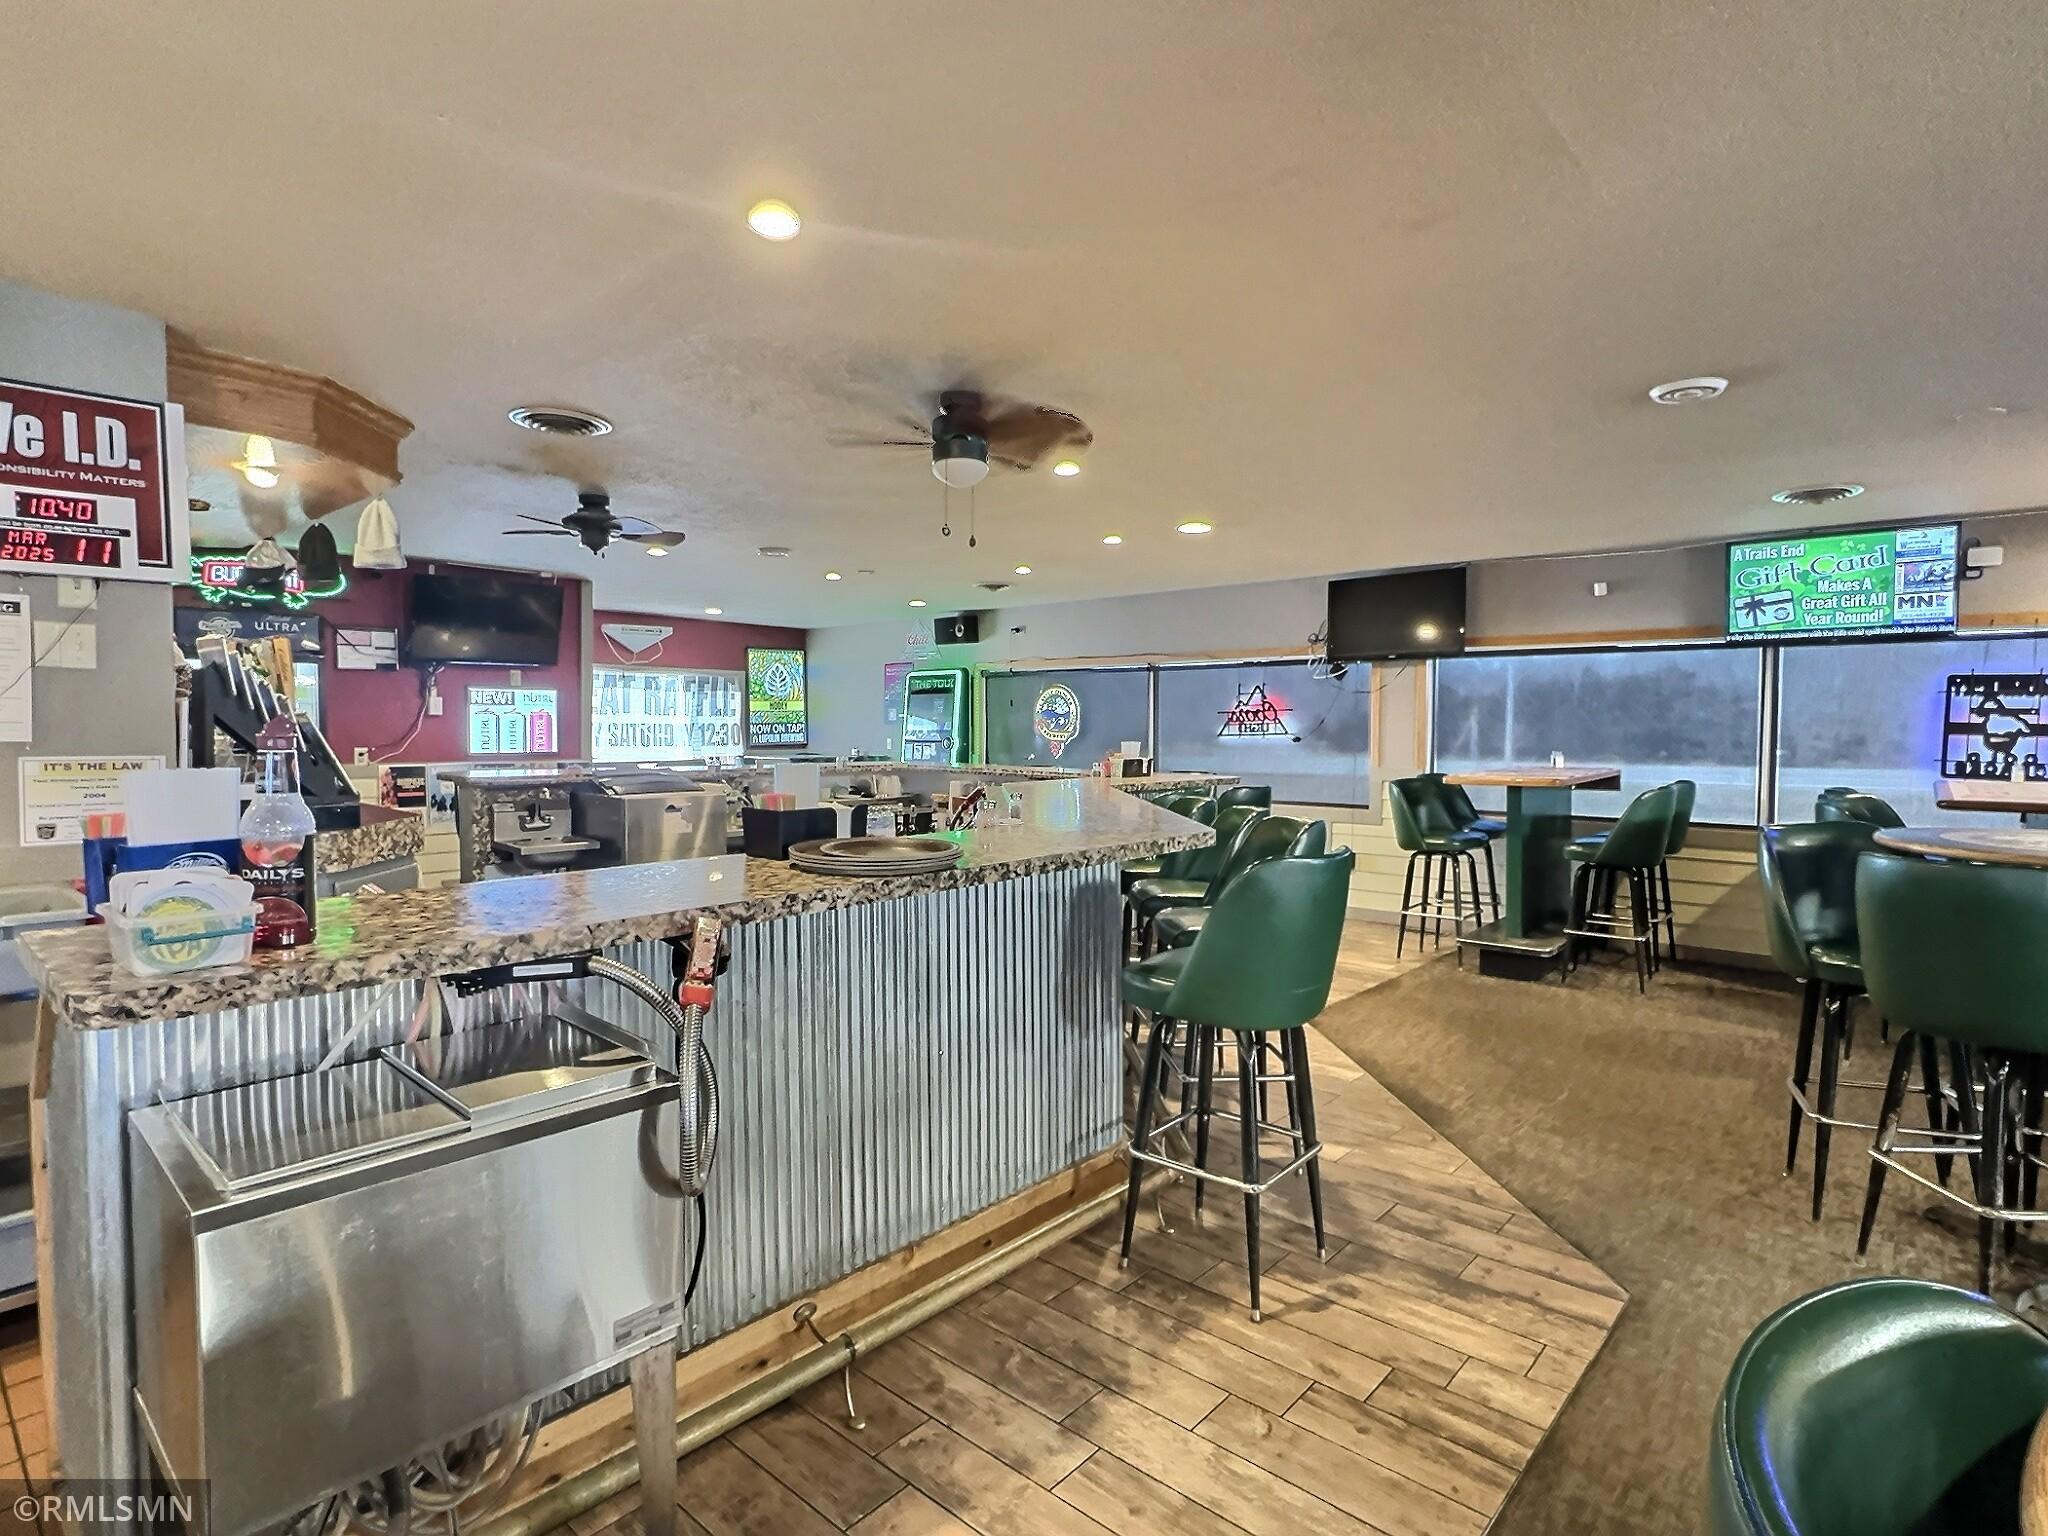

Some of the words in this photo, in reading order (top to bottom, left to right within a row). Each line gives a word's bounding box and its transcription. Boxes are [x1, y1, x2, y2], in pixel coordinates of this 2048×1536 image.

[62, 410, 142, 471] I.D.
[80, 472, 146, 488] MATTERS
[8, 530, 47, 545] MAR
[1, 544, 54, 561] 2025
[1744, 547, 1778, 561] Trails
[1781, 543, 1804, 557] End
[1736, 561, 1801, 589] Gift
[1808, 544, 1891, 577] Card
[1818, 577, 1860, 593] Makes
[1862, 577, 1872, 591] A
[1802, 596, 1839, 610] Great
[1840, 593, 1866, 607] Gift
[1868, 592, 1887, 606] All
[1804, 612, 1833, 626] Year
[1835, 609, 1883, 625] Round!
[254, 621, 300, 632] ULTRA
[470, 691, 514, 705] NEW!
[750, 724, 771, 734] NOW
[773, 723, 785, 733] ON
[44, 763, 72, 771] IT'S
[78, 762, 107, 771] THE
[112, 762, 143, 771] LAW
